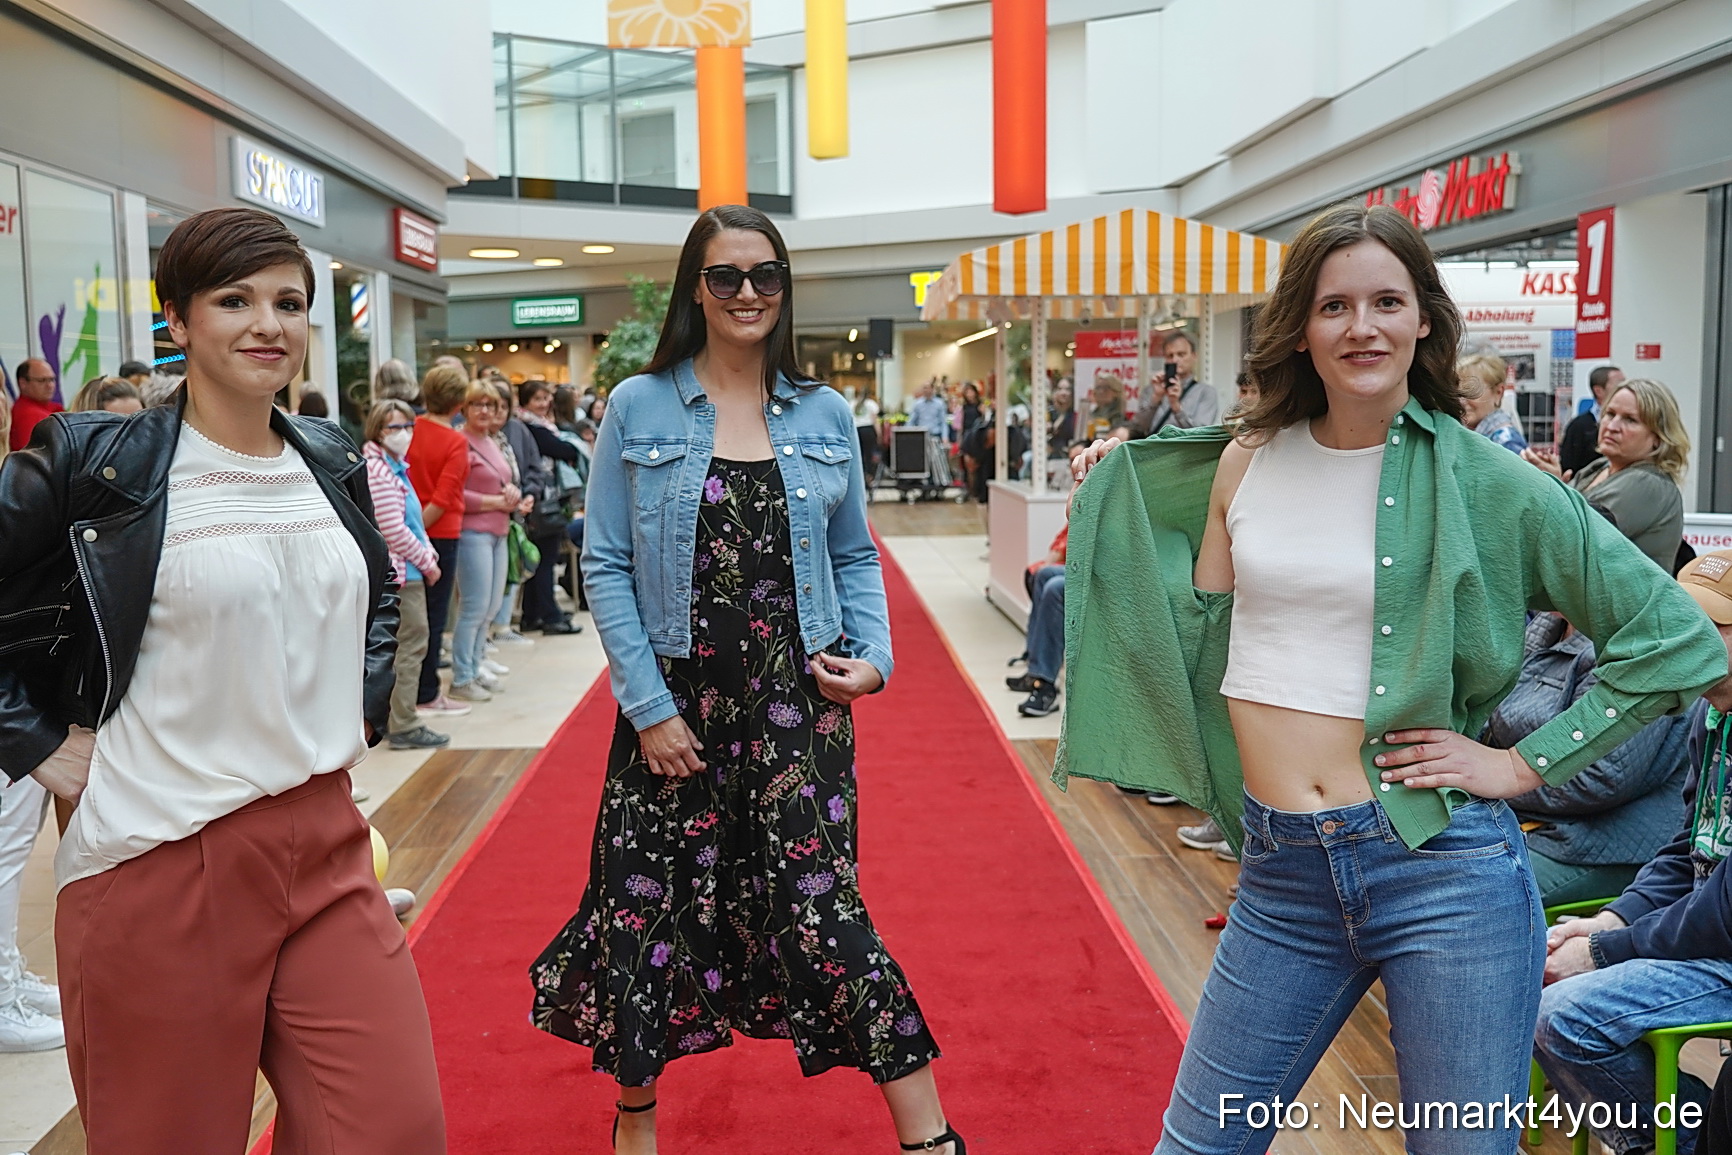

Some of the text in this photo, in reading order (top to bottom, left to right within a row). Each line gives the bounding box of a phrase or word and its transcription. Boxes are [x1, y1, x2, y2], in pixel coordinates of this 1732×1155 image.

[1432, 152, 1512, 227] Markt
[1587, 219, 1607, 296] 1
[1465, 309, 1535, 323] Abholung
